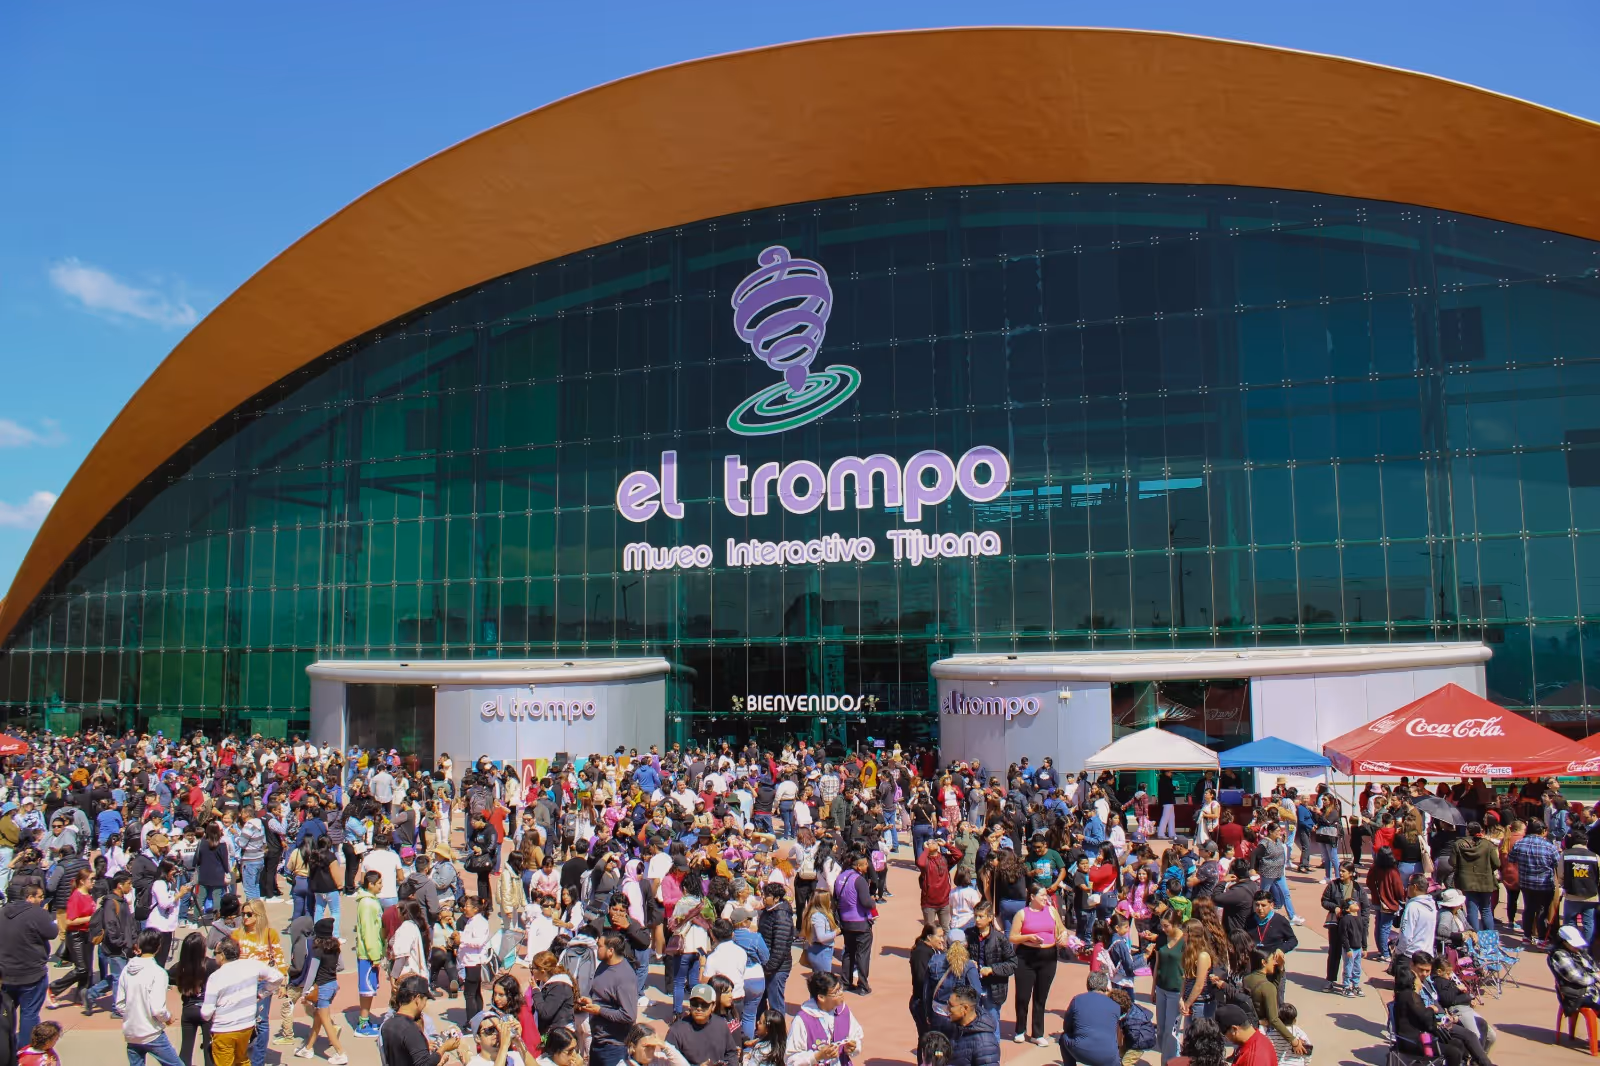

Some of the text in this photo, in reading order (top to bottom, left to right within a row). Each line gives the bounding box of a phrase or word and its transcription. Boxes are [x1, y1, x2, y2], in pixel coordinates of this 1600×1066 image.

[617, 445, 1010, 523] el trompo
[623, 529, 1001, 571] Museo Interactivo Tijuana
[481, 695, 597, 720] el trompo
[747, 694, 865, 712] BIENVENIDOS
[941, 691, 1040, 720] el trompo
[1405, 716, 1503, 737] Coca-Cola
